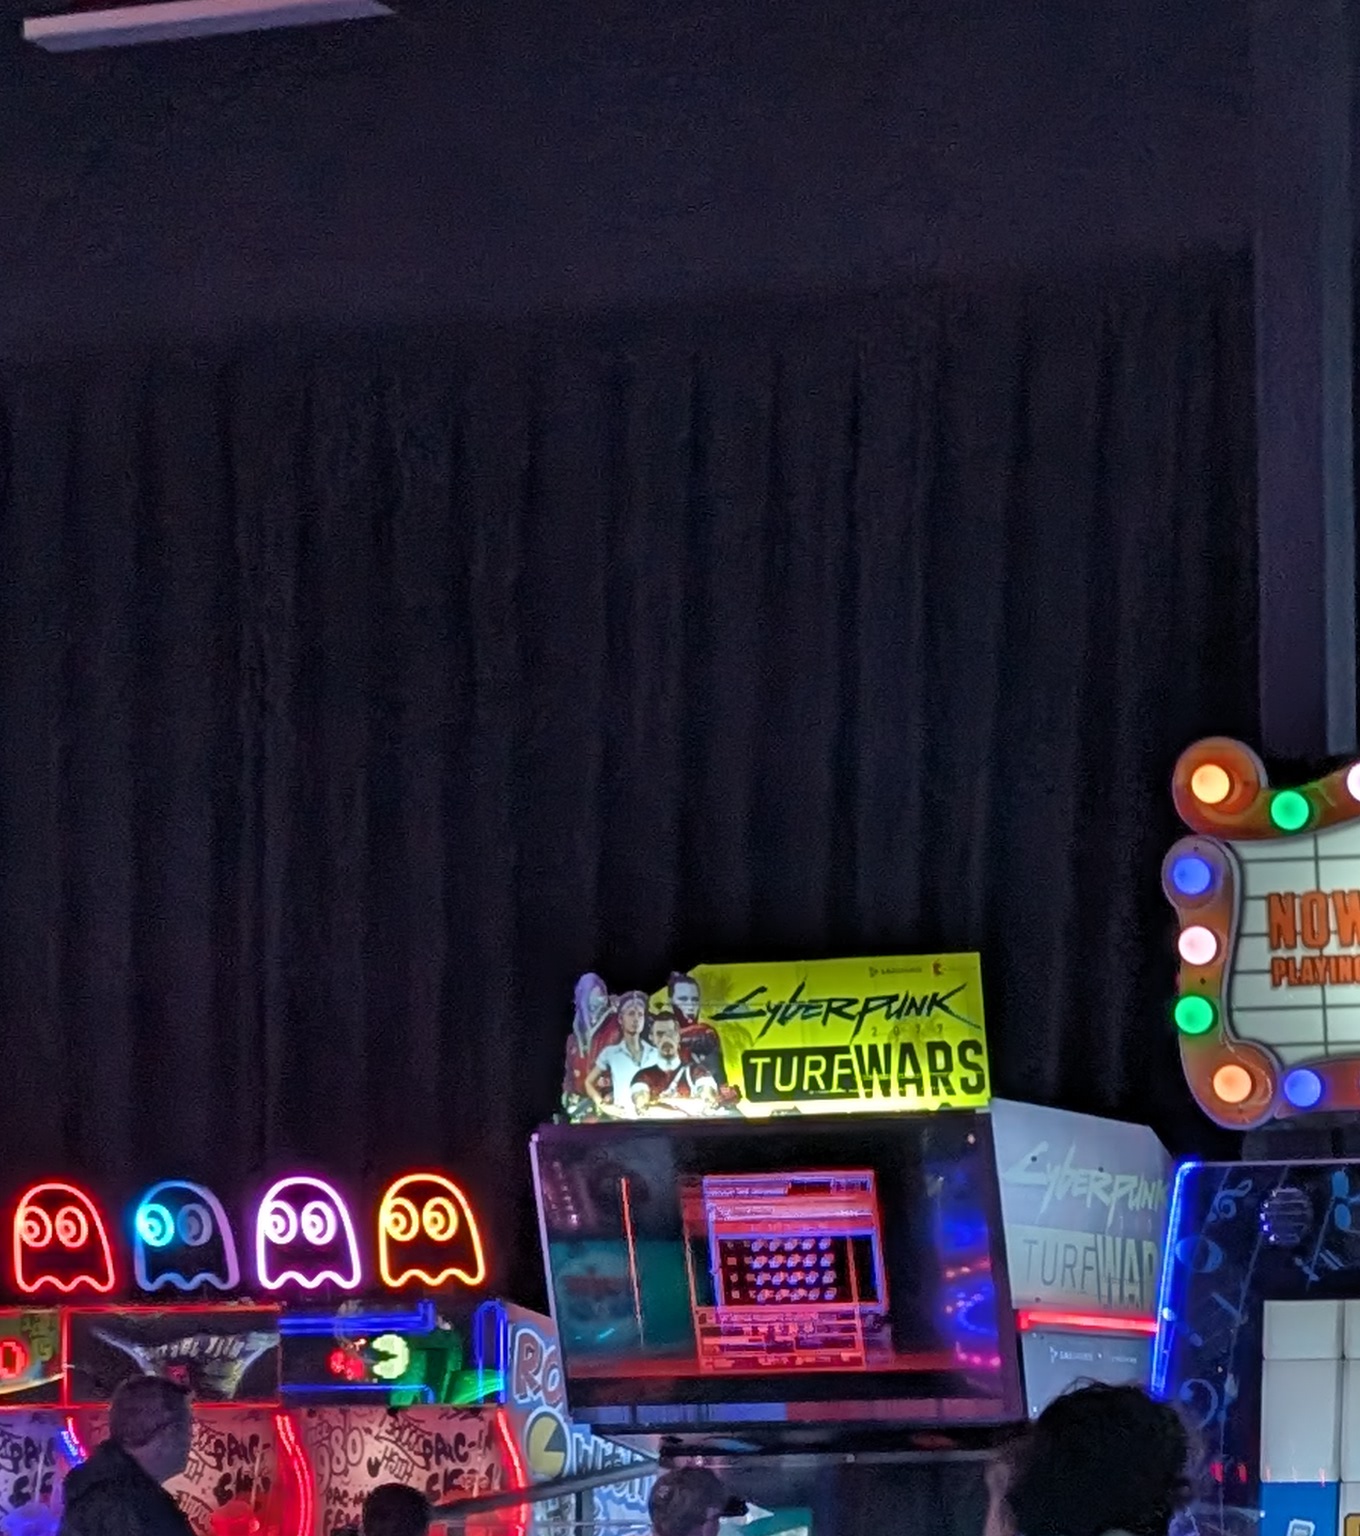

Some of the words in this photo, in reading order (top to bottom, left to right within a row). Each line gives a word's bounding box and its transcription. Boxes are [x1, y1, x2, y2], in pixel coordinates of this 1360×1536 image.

[749, 1053, 853, 1094] TURF
[853, 1040, 986, 1098] WARS
[1023, 1238, 1096, 1291] TURF
